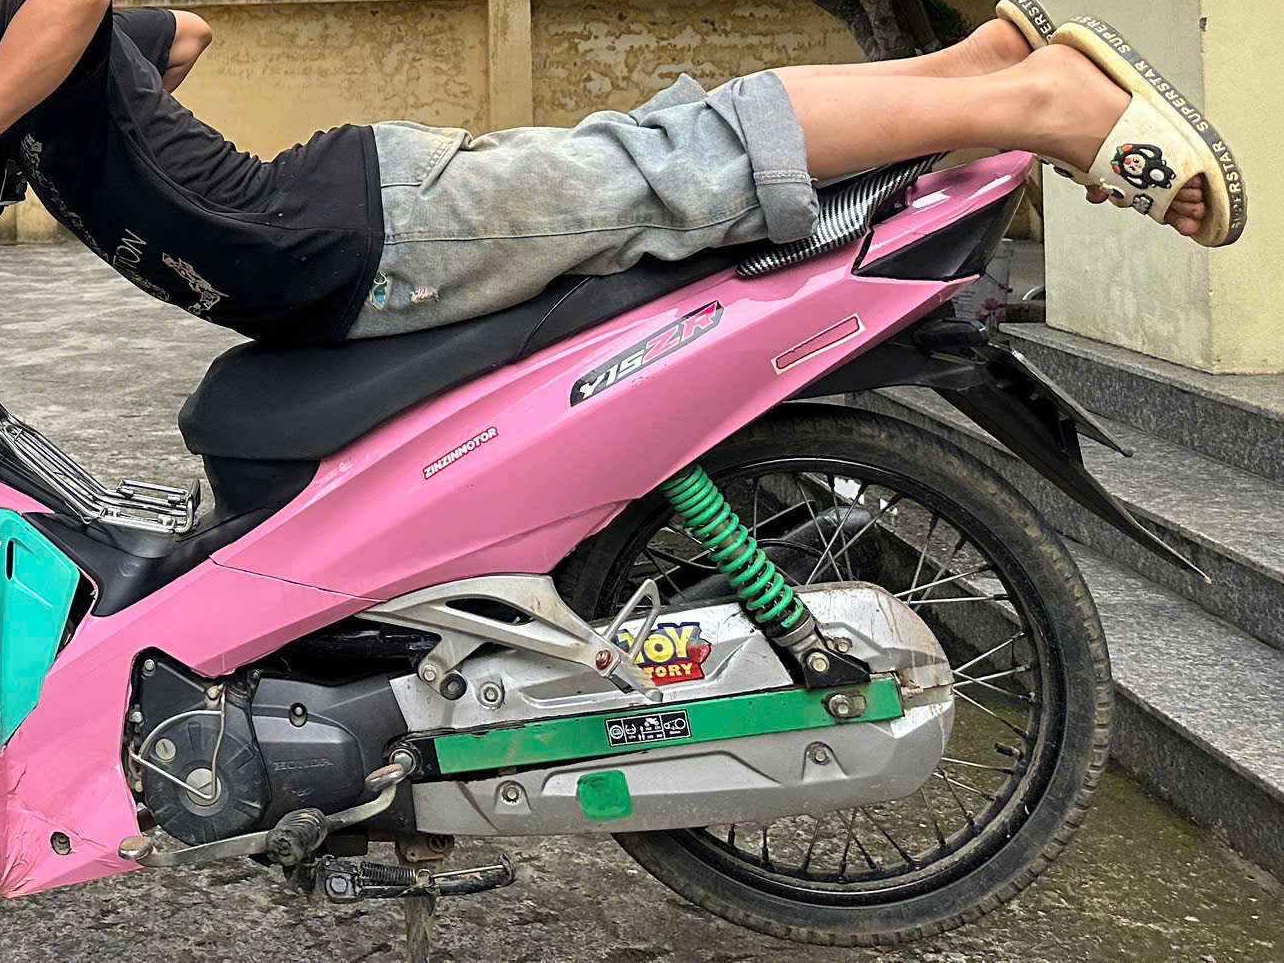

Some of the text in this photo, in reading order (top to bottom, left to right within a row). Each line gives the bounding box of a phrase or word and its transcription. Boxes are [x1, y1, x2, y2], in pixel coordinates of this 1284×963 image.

[1134, 60, 1209, 132] SUPERSTAR
[579, 303, 717, 399] Y15ZR
[644, 662, 693, 680] TORY
